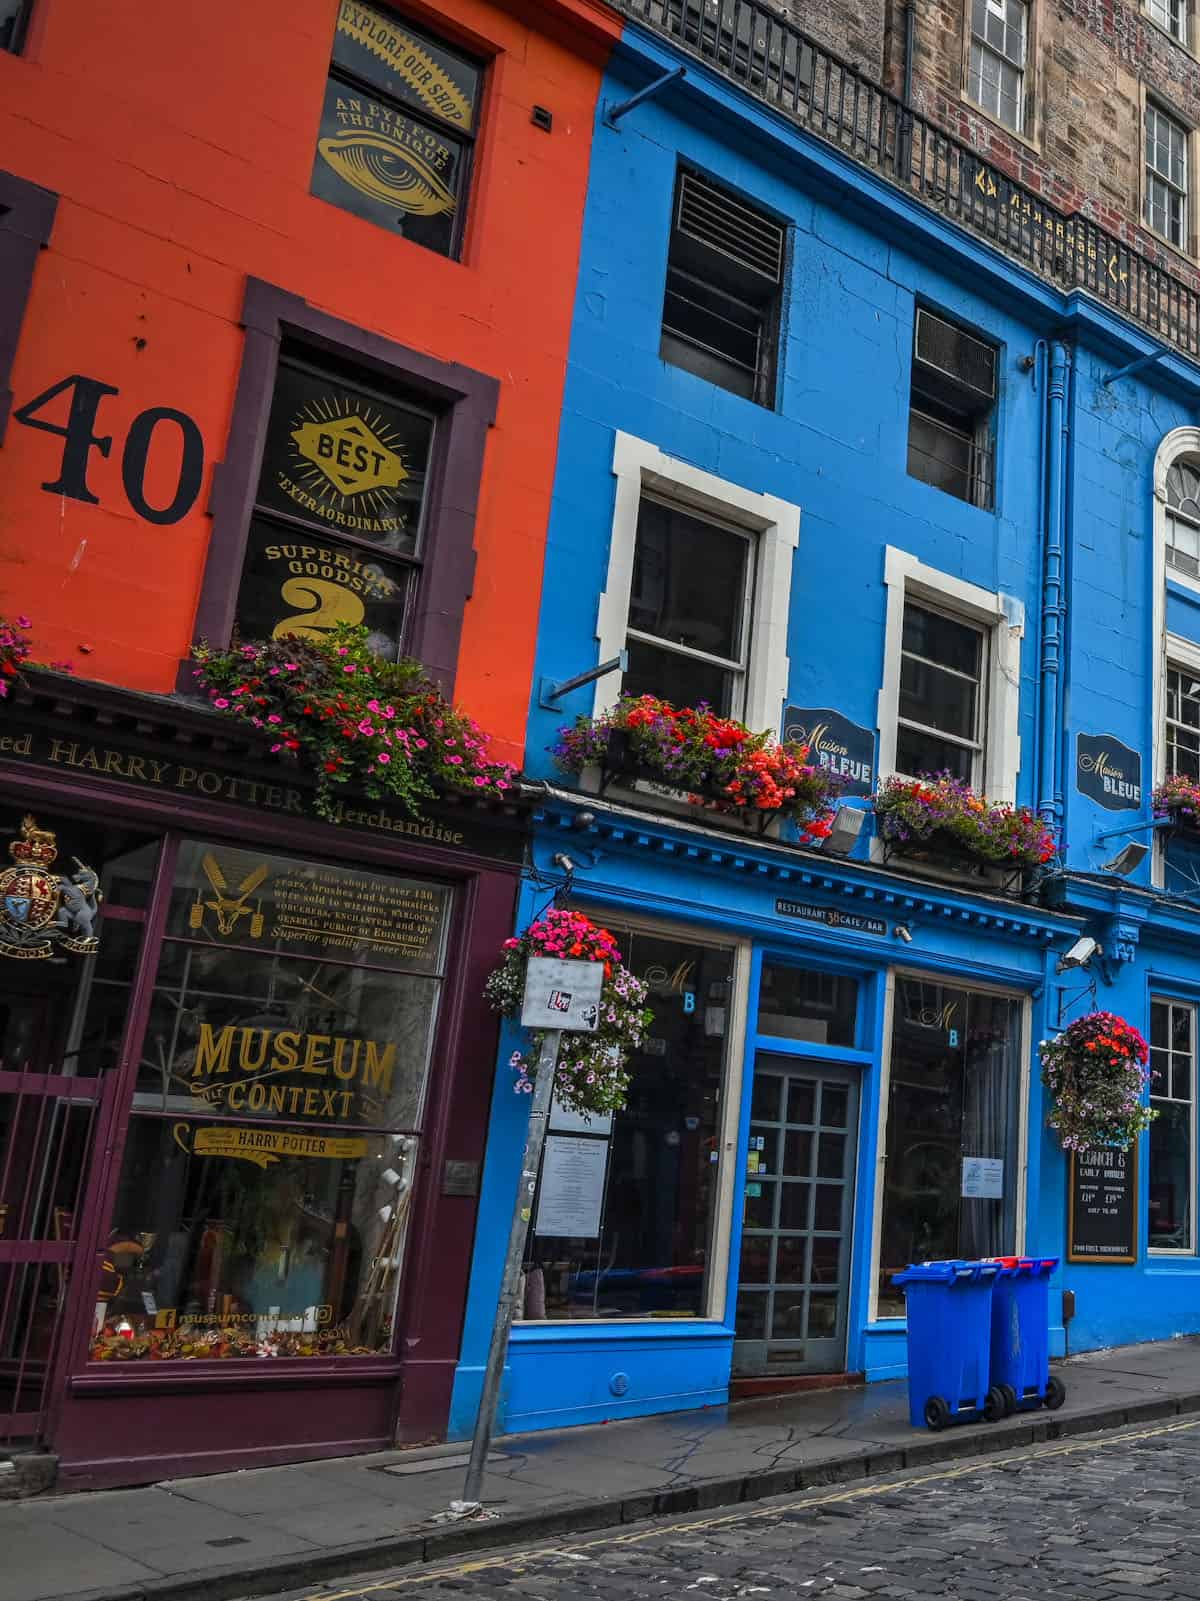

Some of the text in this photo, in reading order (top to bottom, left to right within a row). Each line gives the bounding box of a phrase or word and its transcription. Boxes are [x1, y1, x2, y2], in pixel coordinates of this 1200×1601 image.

[341, 3, 464, 120] EXPLORE OUR SHOP
[336, 98, 449, 160] AN EYE FOR
[336, 112, 446, 170] THE UNIQUE
[14, 374, 204, 525] 40
[317, 433, 386, 477] BEST
[265, 545, 395, 596] SUPERIOR
[790, 722, 849, 757] Maison
[820, 751, 871, 784] BLEUE
[1088, 752, 1124, 780] Maison
[48, 738, 172, 783] HARRY
[175, 766, 304, 814] POTTER
[335, 801, 466, 845] erchandise
[1104, 775, 1141, 801] BLEUE
[304, 894, 326, 906] sold
[330, 897, 340, 906] to
[343, 878, 368, 891] shop
[370, 881, 387, 893] for
[390, 887, 411, 897] over
[356, 891, 375, 902] and
[379, 893, 440, 913] broomsticks
[776, 902, 827, 920] RESTAURANT
[271, 926, 320, 944] Superior
[321, 935, 360, 952] quality
[395, 920, 414, 932] and
[417, 923, 433, 935] the
[682, 991, 696, 1015] B
[949, 1030, 960, 1047] B
[192, 1023, 398, 1096] MUSEUM
[228, 1082, 355, 1118] CONTEXT
[238, 1131, 327, 1153] HARRY POTTER
